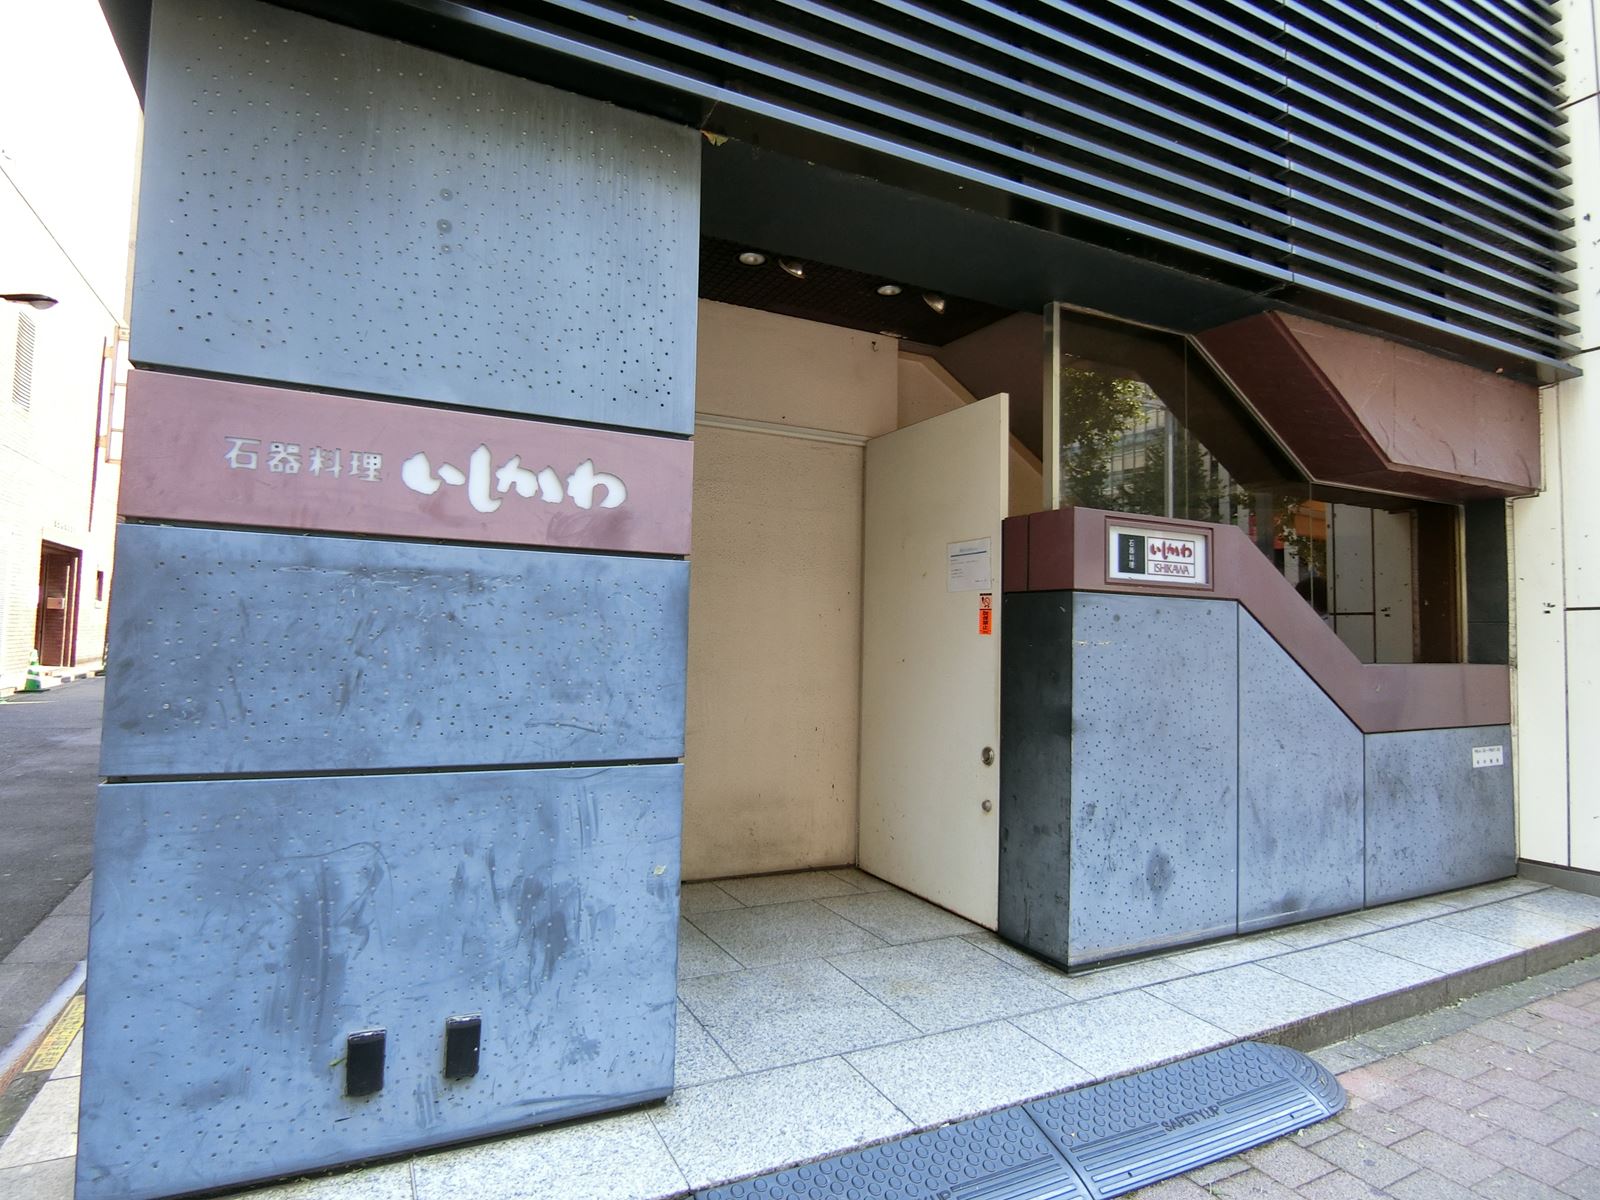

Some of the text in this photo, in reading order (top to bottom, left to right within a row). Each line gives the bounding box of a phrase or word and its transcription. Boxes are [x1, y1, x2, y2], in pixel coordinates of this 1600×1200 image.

[223, 436, 627, 513] 石器料理 いしかわ
[1149, 540, 1193, 560] いしかわ
[1153, 563, 1190, 575] ISHIKAWA
